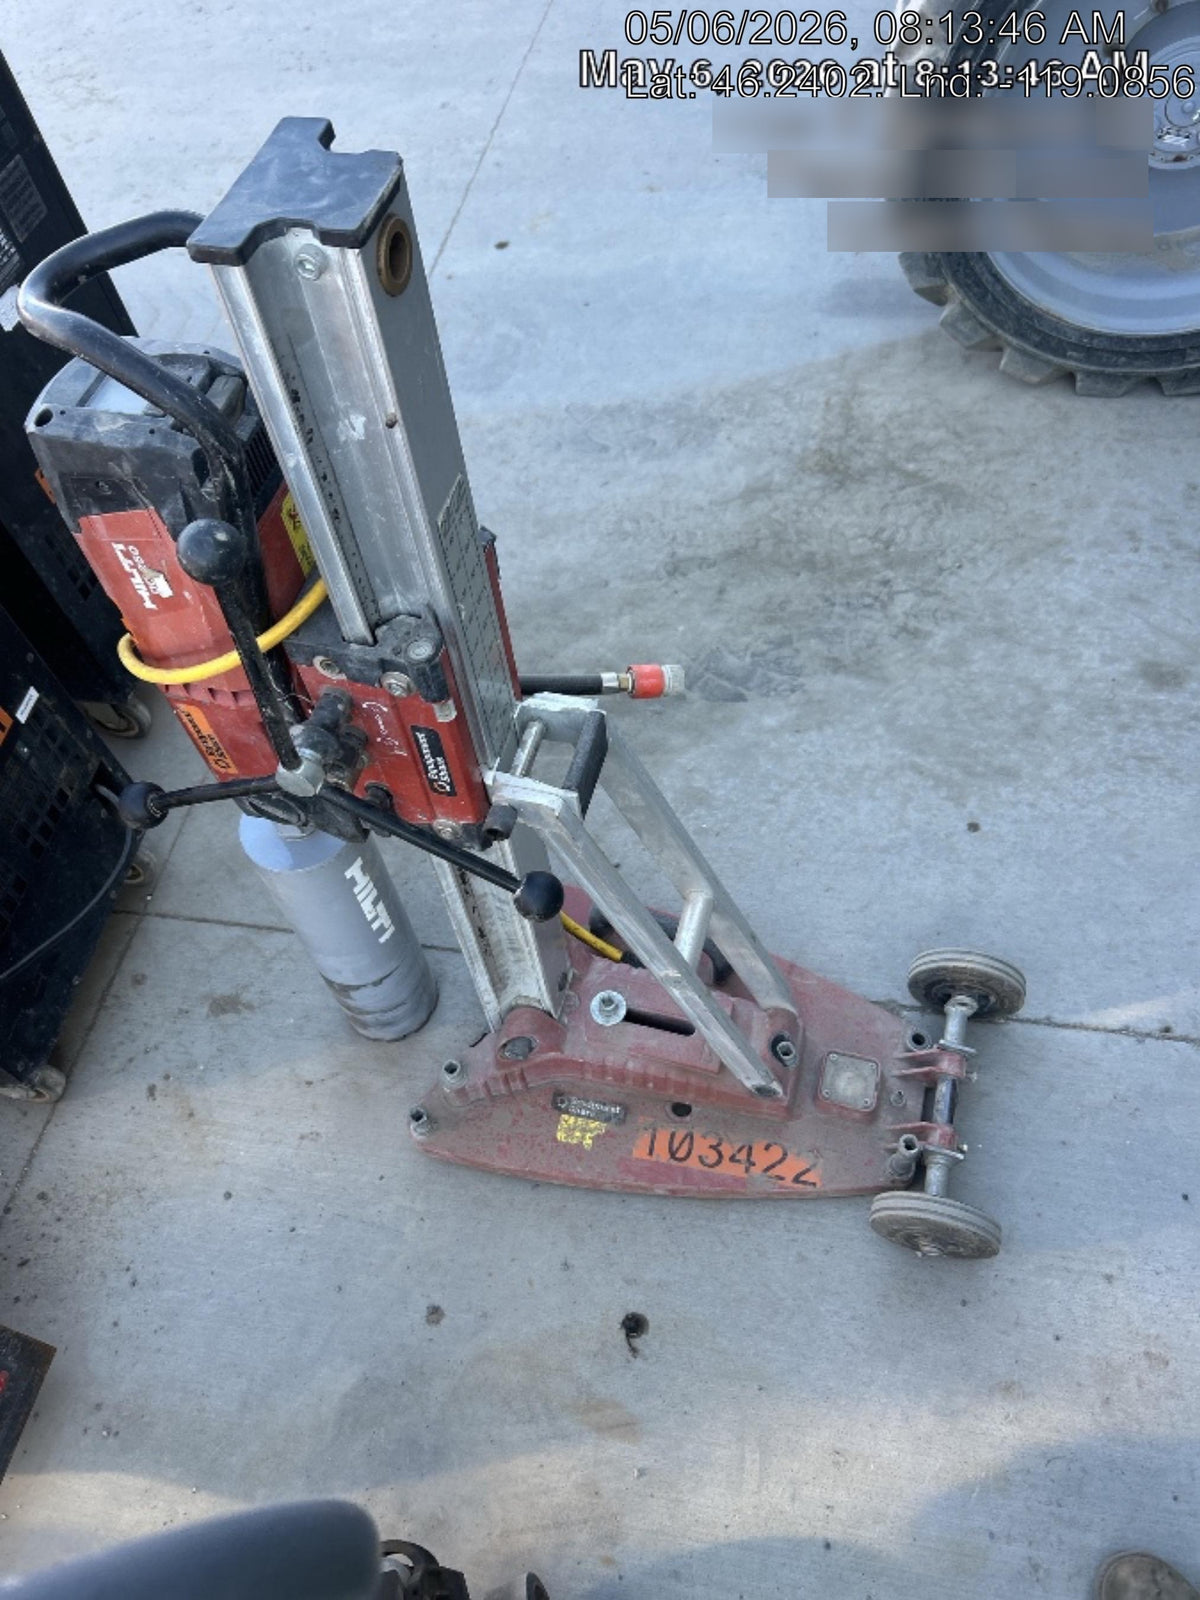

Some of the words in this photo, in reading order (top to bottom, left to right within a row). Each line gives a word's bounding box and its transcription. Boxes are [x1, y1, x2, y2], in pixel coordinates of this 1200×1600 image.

[111, 542, 158, 610] HILTI
[344, 856, 395, 943] HILTI
[644, 1127, 819, 1188] 103422
